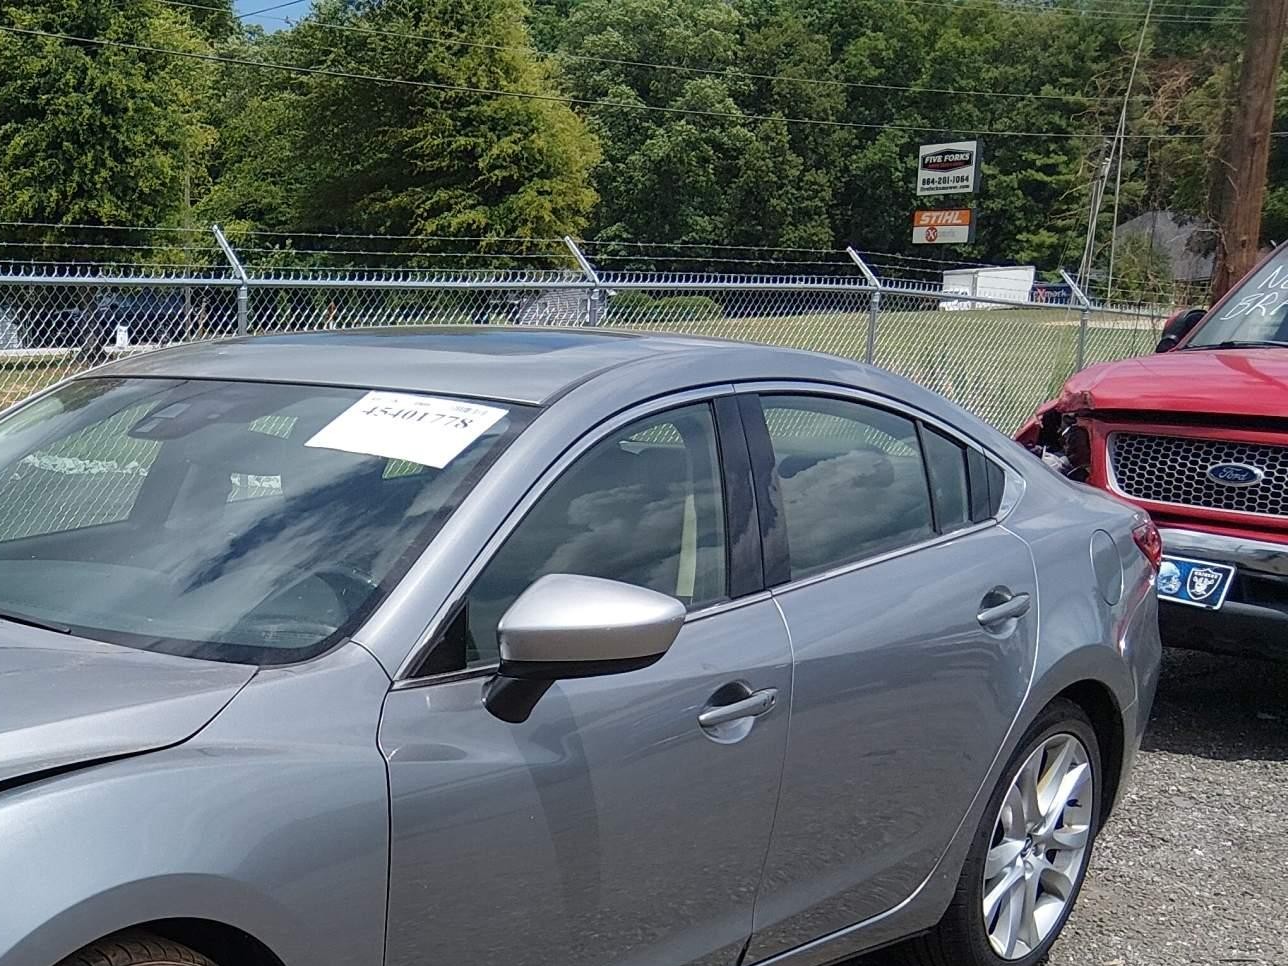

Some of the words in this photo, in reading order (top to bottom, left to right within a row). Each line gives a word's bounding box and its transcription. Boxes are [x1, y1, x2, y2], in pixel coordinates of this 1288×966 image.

[925, 156, 943, 164] FIVE
[944, 153, 970, 162] FORKS
[920, 210, 962, 224] STIHL
[362, 406, 473, 429] 45401778
[1218, 467, 1249, 481] Ford
